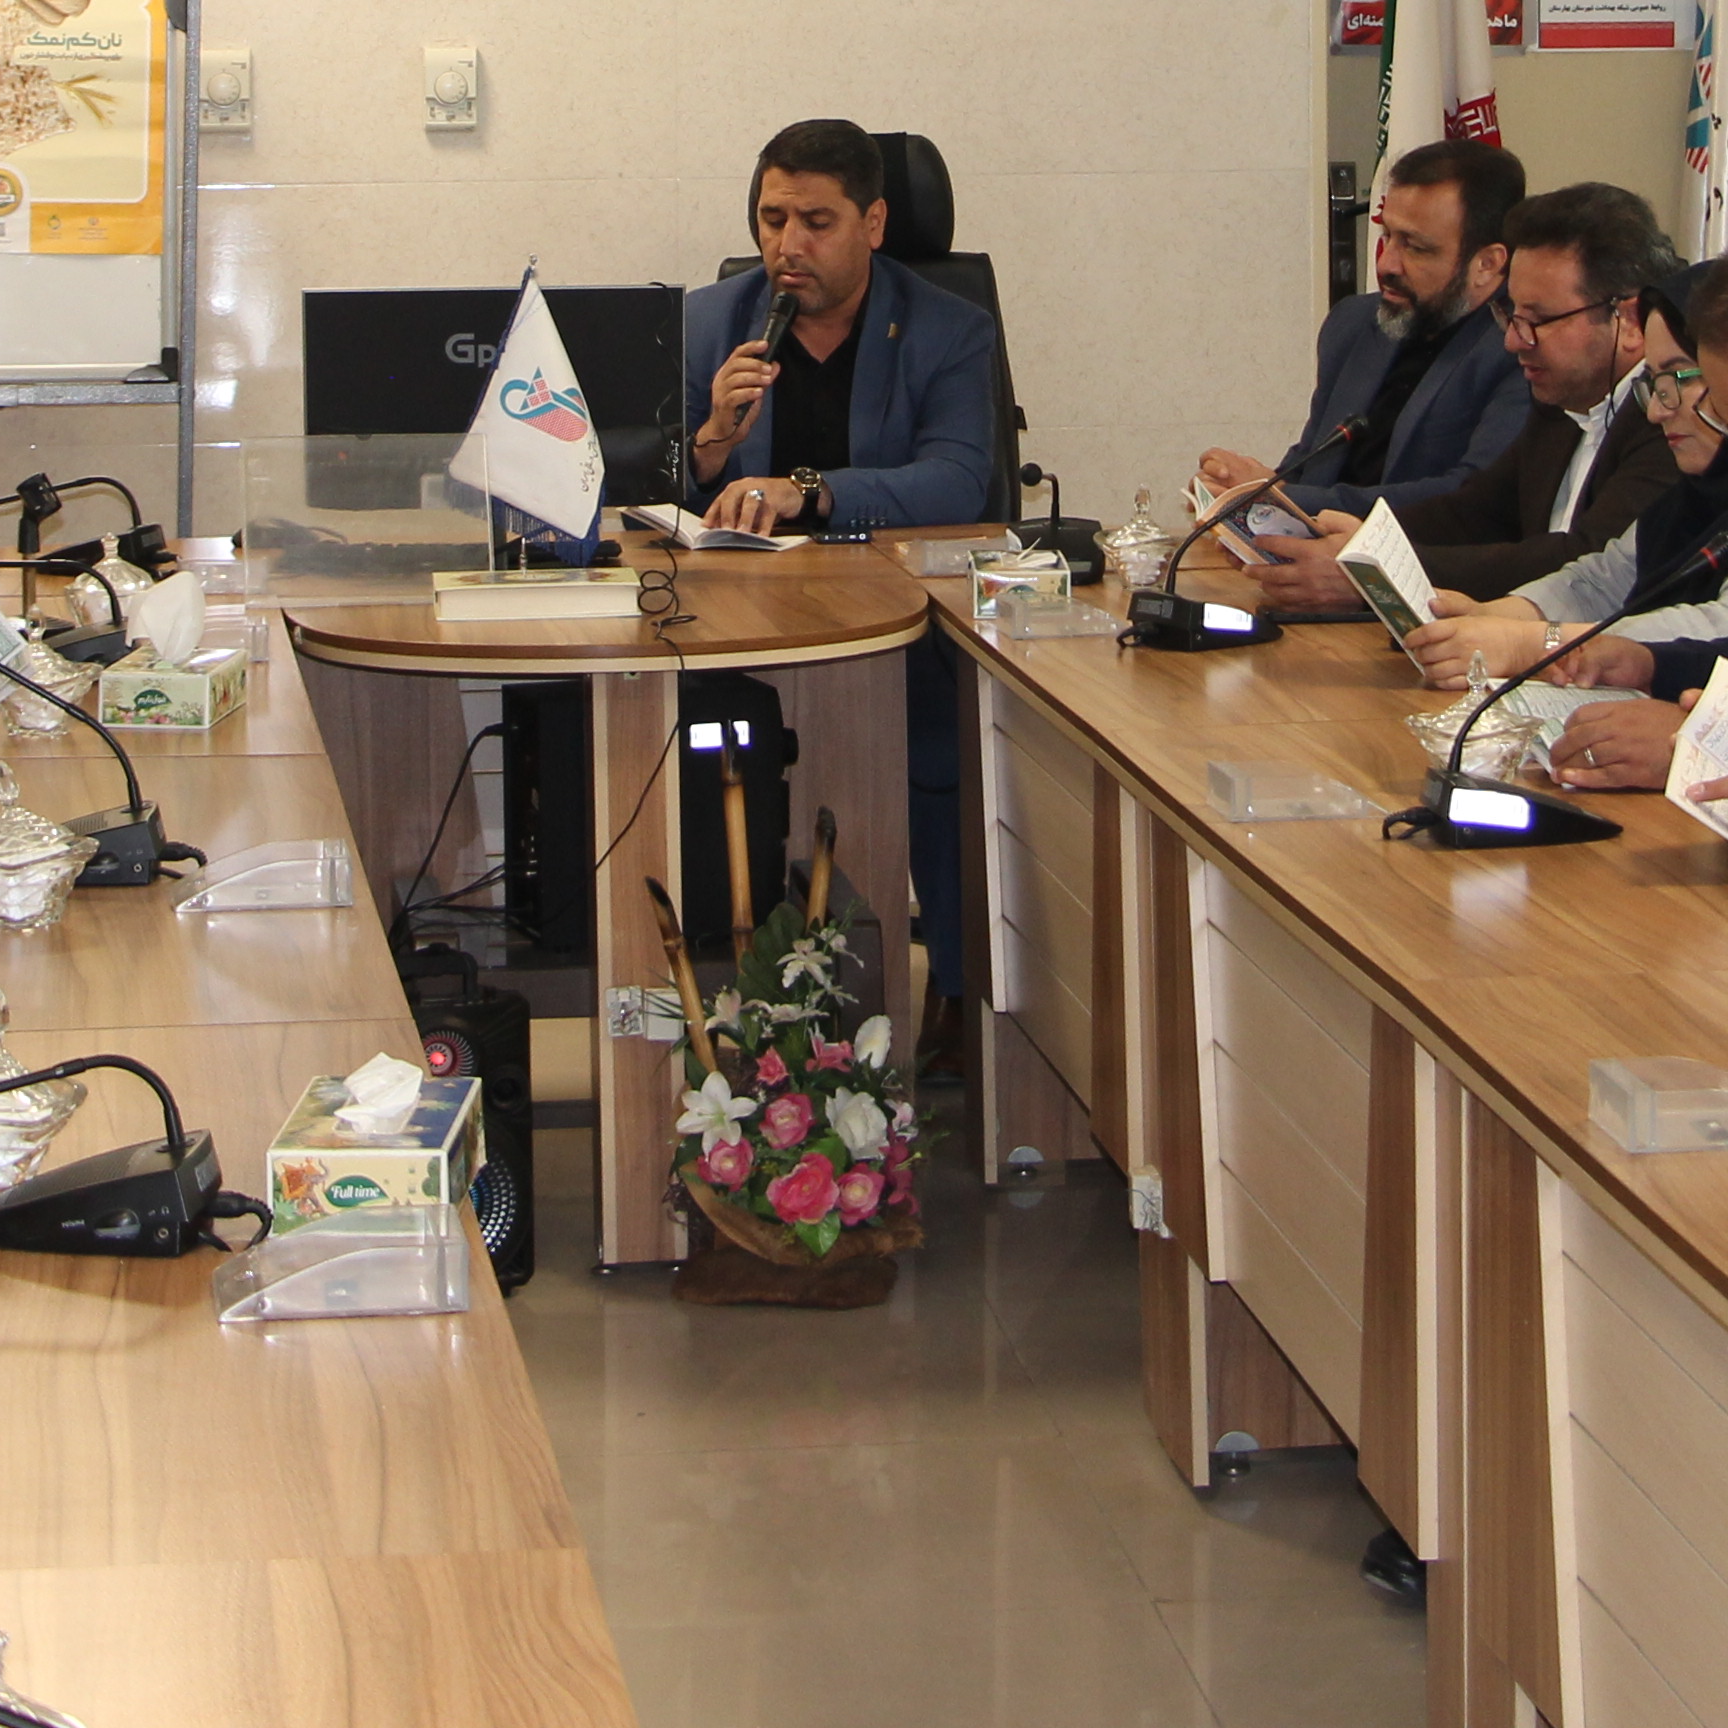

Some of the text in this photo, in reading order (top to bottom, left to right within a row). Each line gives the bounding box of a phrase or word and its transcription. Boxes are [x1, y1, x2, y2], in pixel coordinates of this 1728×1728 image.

[98, 32, 122, 50] نان
[444, 332, 498, 369] Gp
[331, 1184, 381, 1200] Full time
